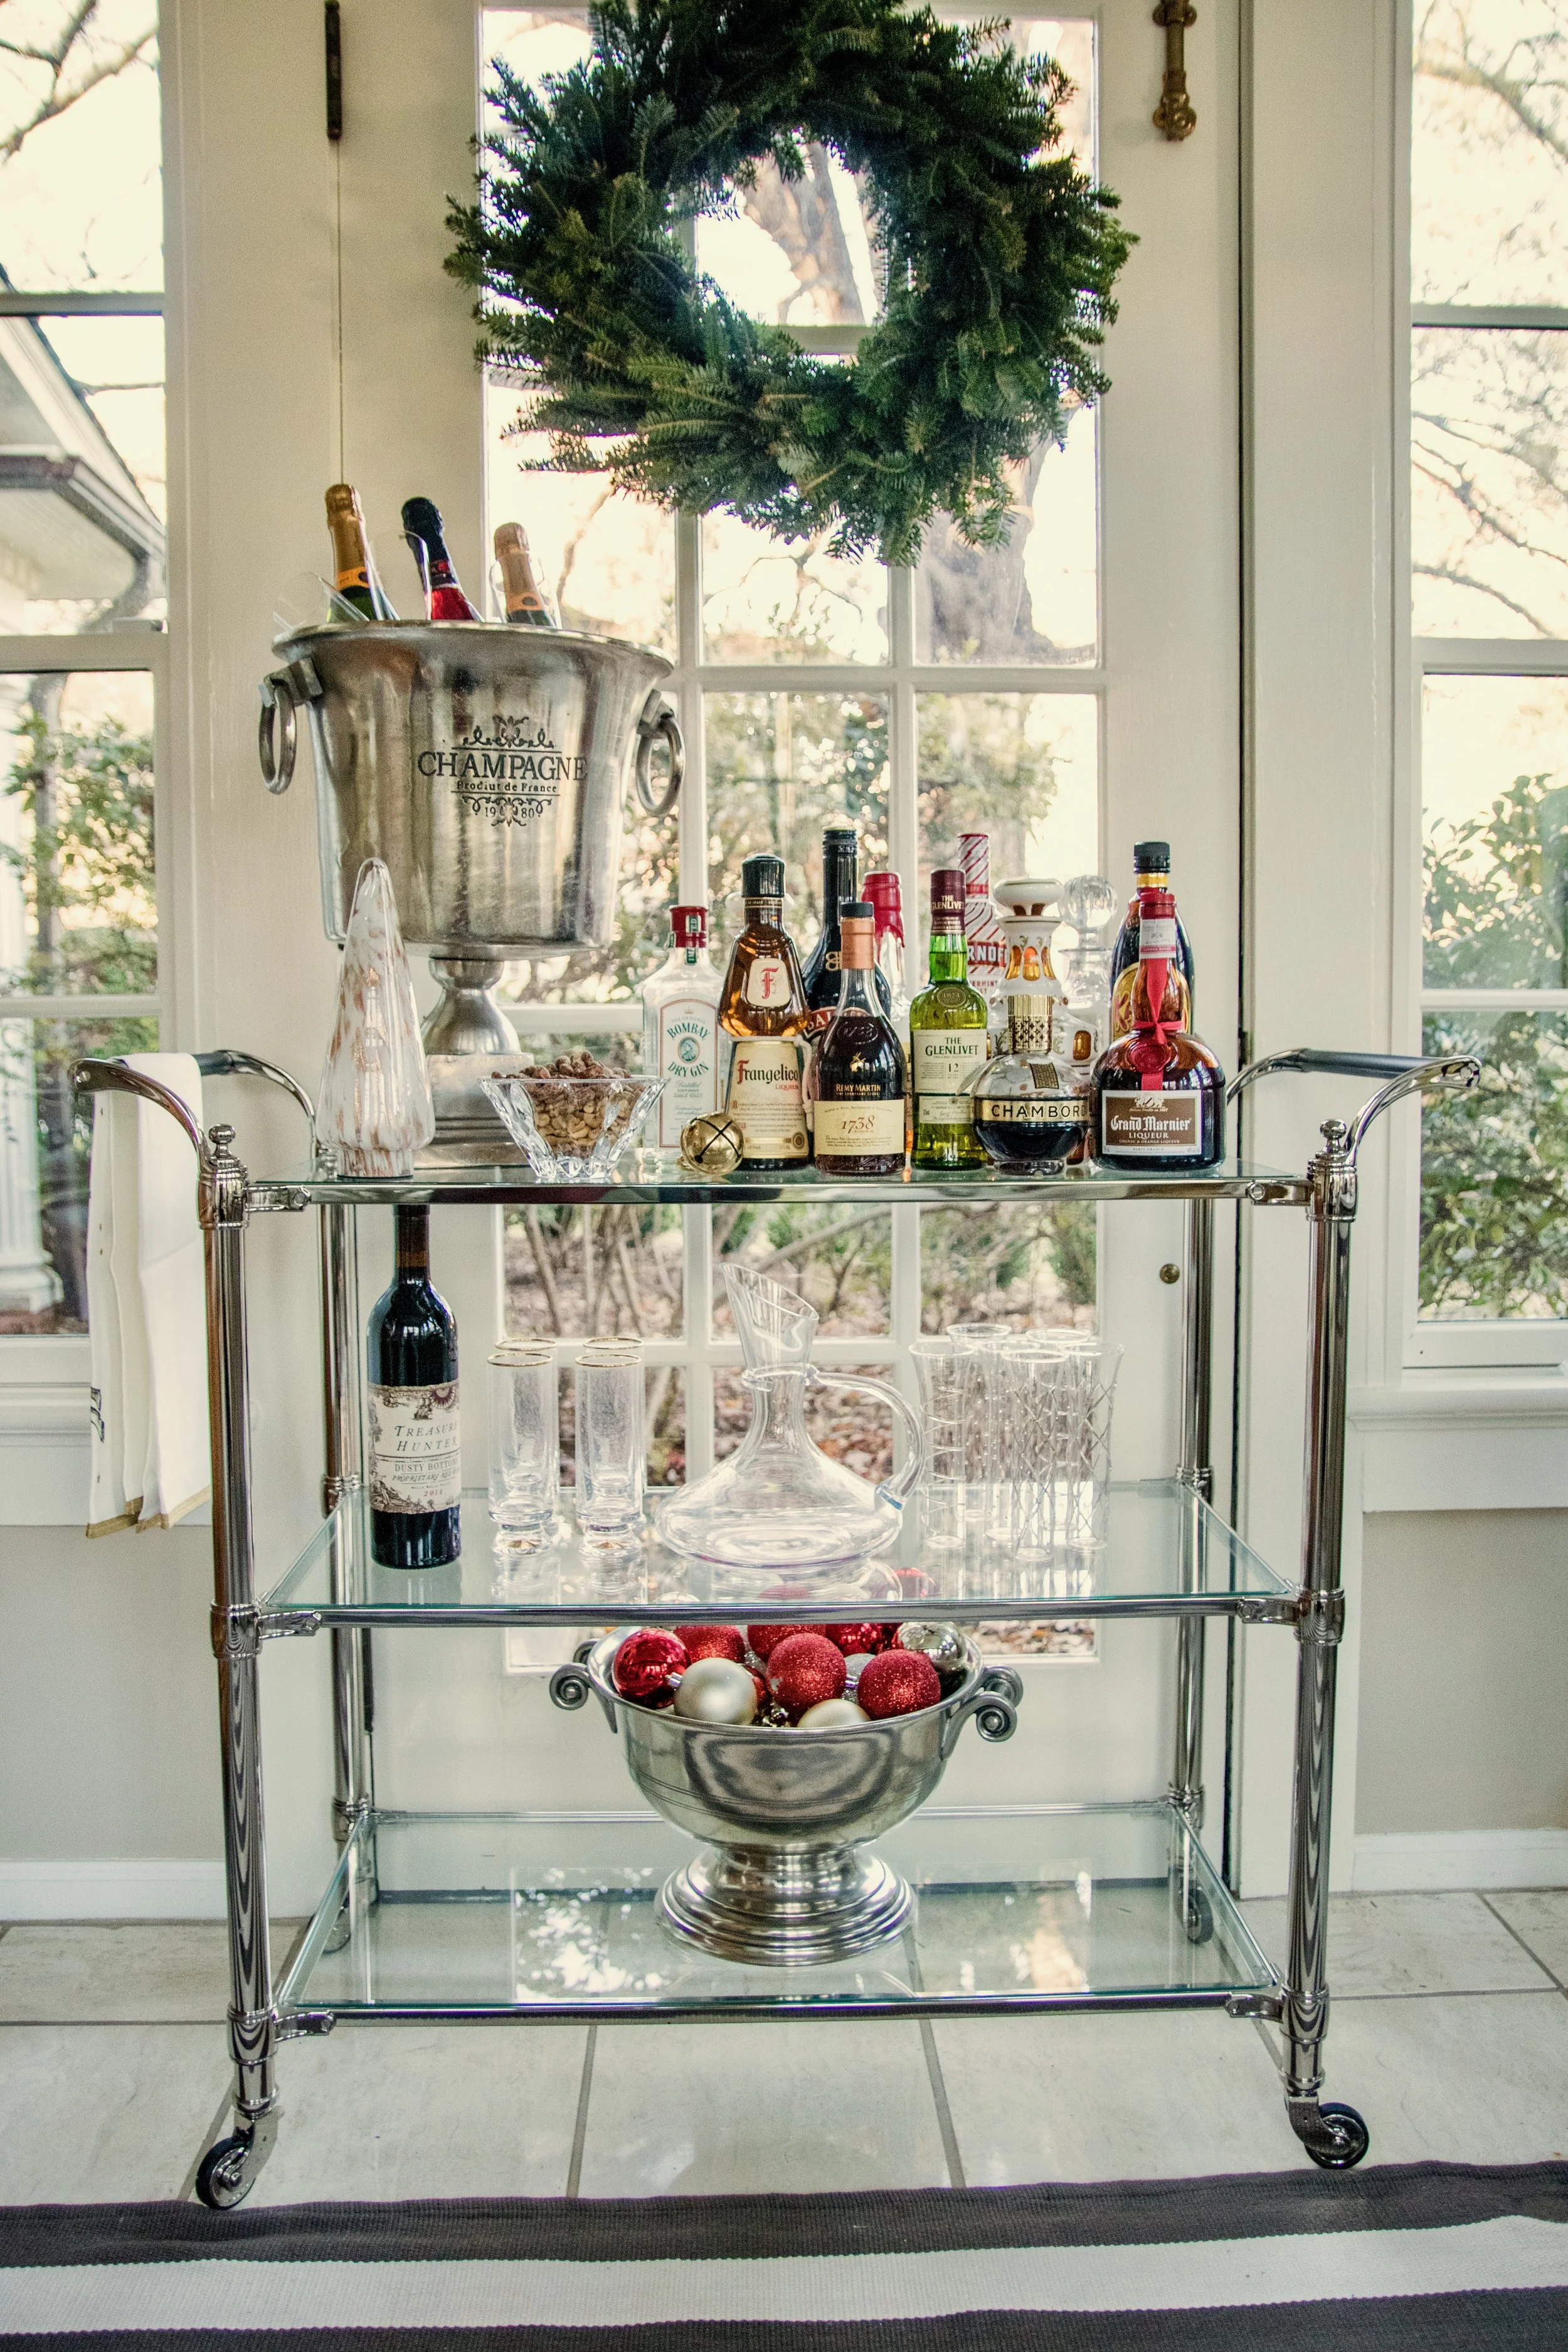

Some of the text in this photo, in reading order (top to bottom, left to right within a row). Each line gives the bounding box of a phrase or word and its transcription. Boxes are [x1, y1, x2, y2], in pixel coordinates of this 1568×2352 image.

[417, 751, 588, 781] CHAMPAGNE
[504, 782, 517, 792] de
[521, 783, 557, 793] France
[931, 901, 965, 910] GLENLIVET
[967, 945, 1007, 964] RNOF
[760, 967, 779, 999] F
[667, 1022, 711, 1041] BOMBAY
[945, 1037, 962, 1045] THE
[925, 1045, 979, 1056] GLENLIVET
[667, 1061, 709, 1078] DRY GIN
[736, 1059, 799, 1084] Frangelico
[948, 1063, 959, 1073] 12
[991, 1104, 1086, 1118] CHAMBORD
[842, 1115, 875, 1134] 1738
[1110, 1115, 1191, 1131] Grand Marnier
[395, 1421, 457, 1437] TREASURE
[396, 1436, 457, 1451] HUNTER
[395, 1464, 425, 1472] DUSTY
